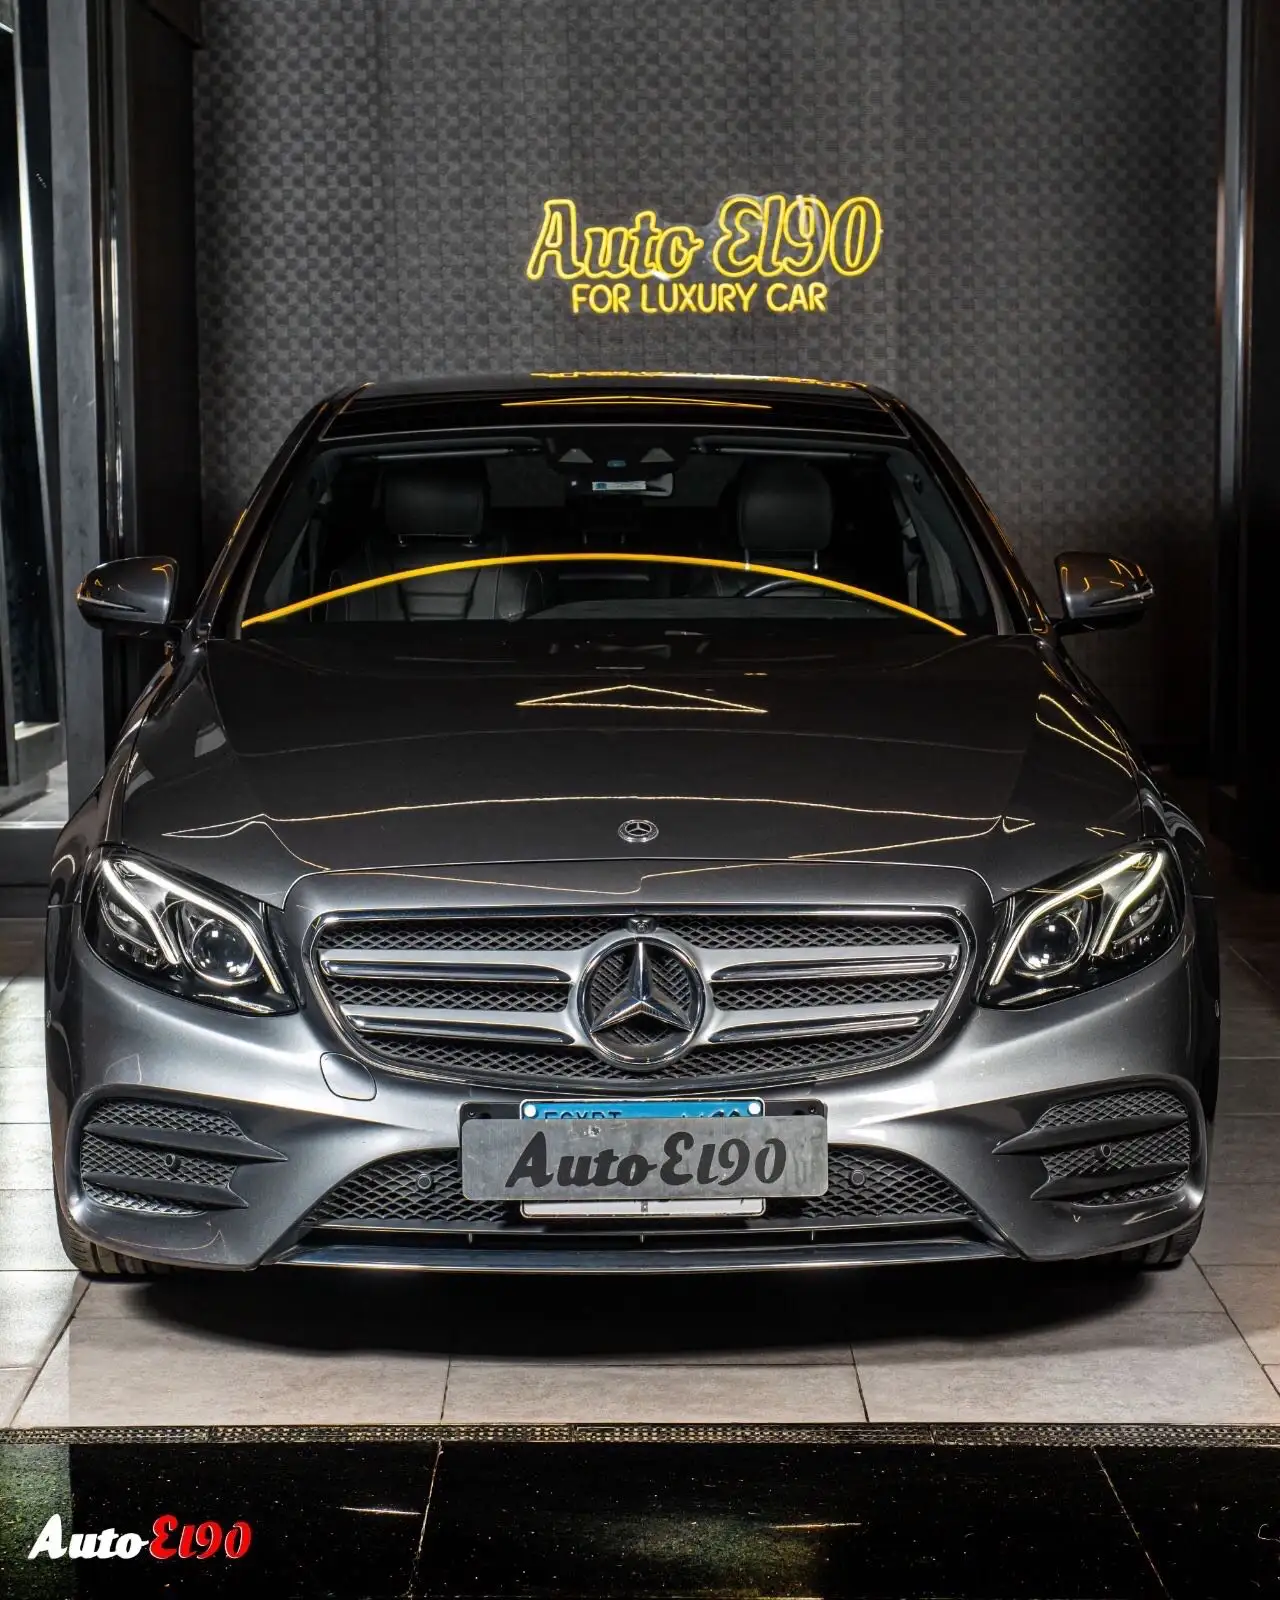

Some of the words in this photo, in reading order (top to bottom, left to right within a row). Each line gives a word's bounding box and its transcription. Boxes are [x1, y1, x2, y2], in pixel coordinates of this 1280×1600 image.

[526, 198, 703, 280] Auto
[572, 283, 630, 313] FOR
[641, 283, 758, 313] LUXURY
[766, 282, 828, 312] CAR
[505, 1131, 657, 1187] Auto
